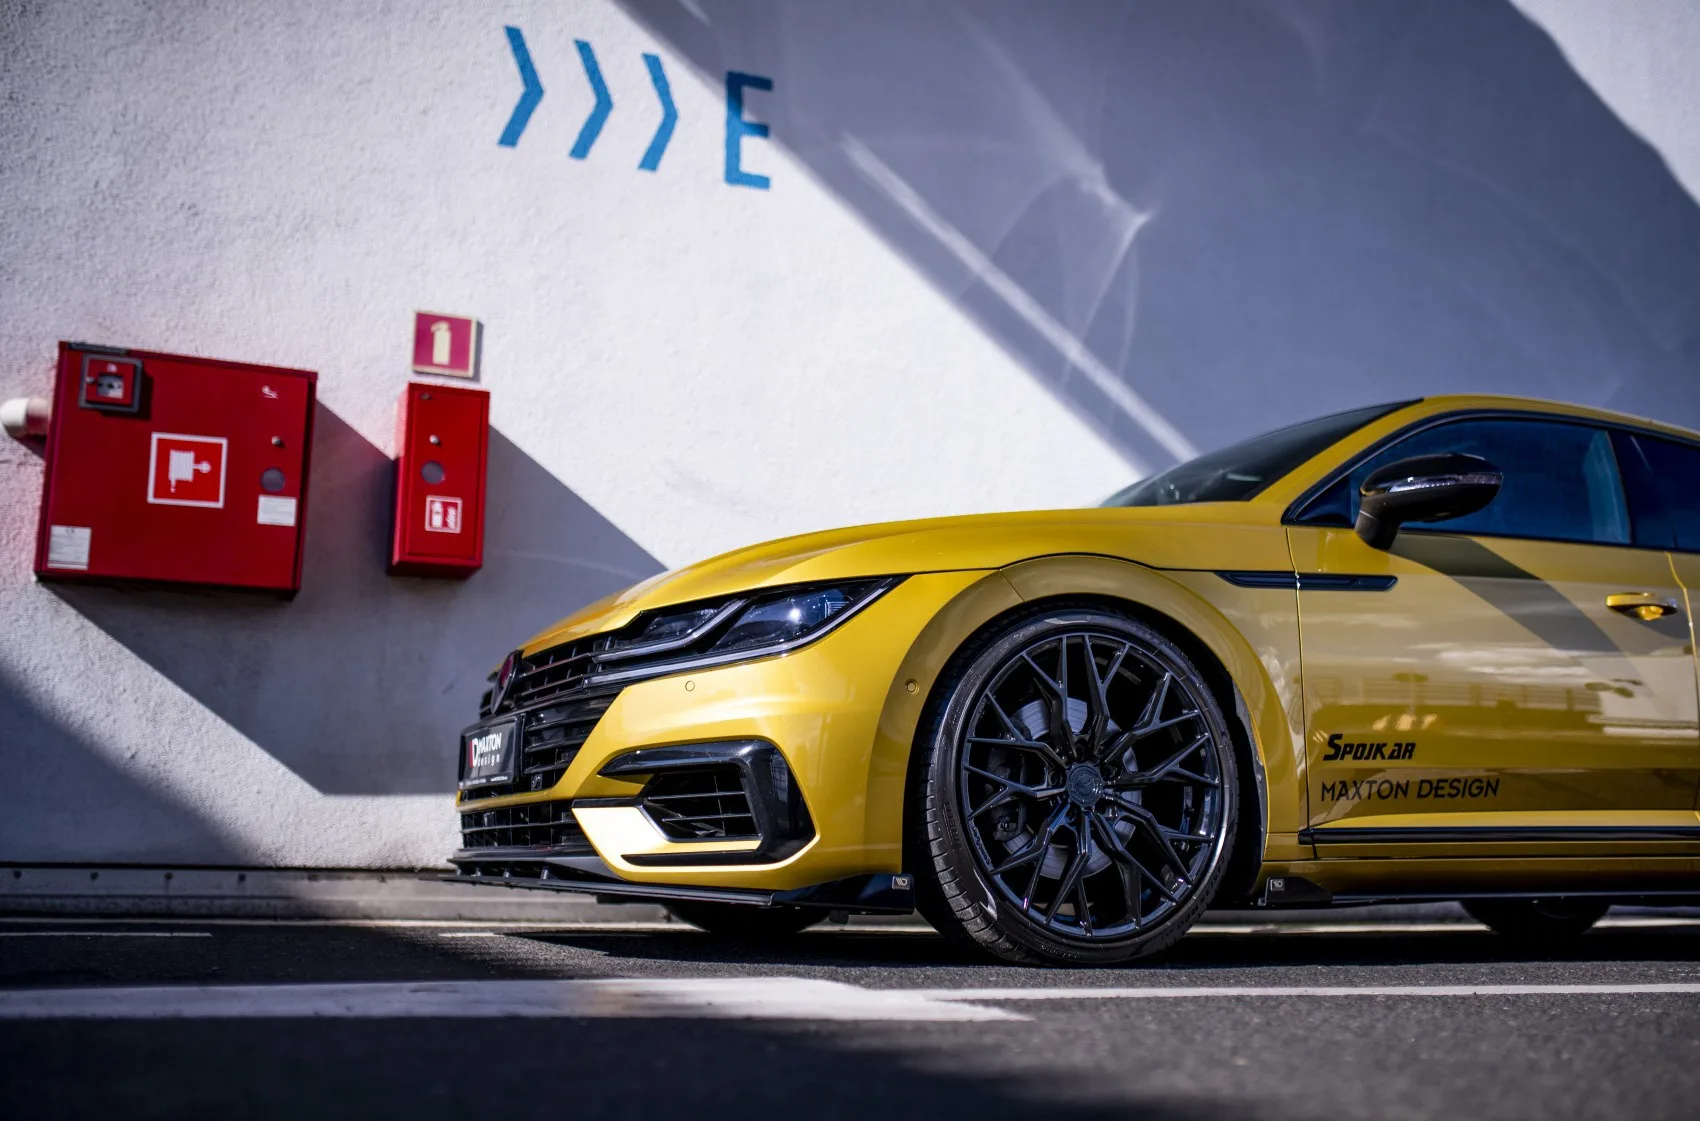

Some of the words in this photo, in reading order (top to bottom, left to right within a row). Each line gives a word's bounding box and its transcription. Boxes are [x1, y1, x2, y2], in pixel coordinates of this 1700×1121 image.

[725, 71, 773, 189] E
[1321, 778, 1410, 802] MAXTON
[1416, 778, 1500, 799] DESIGN
